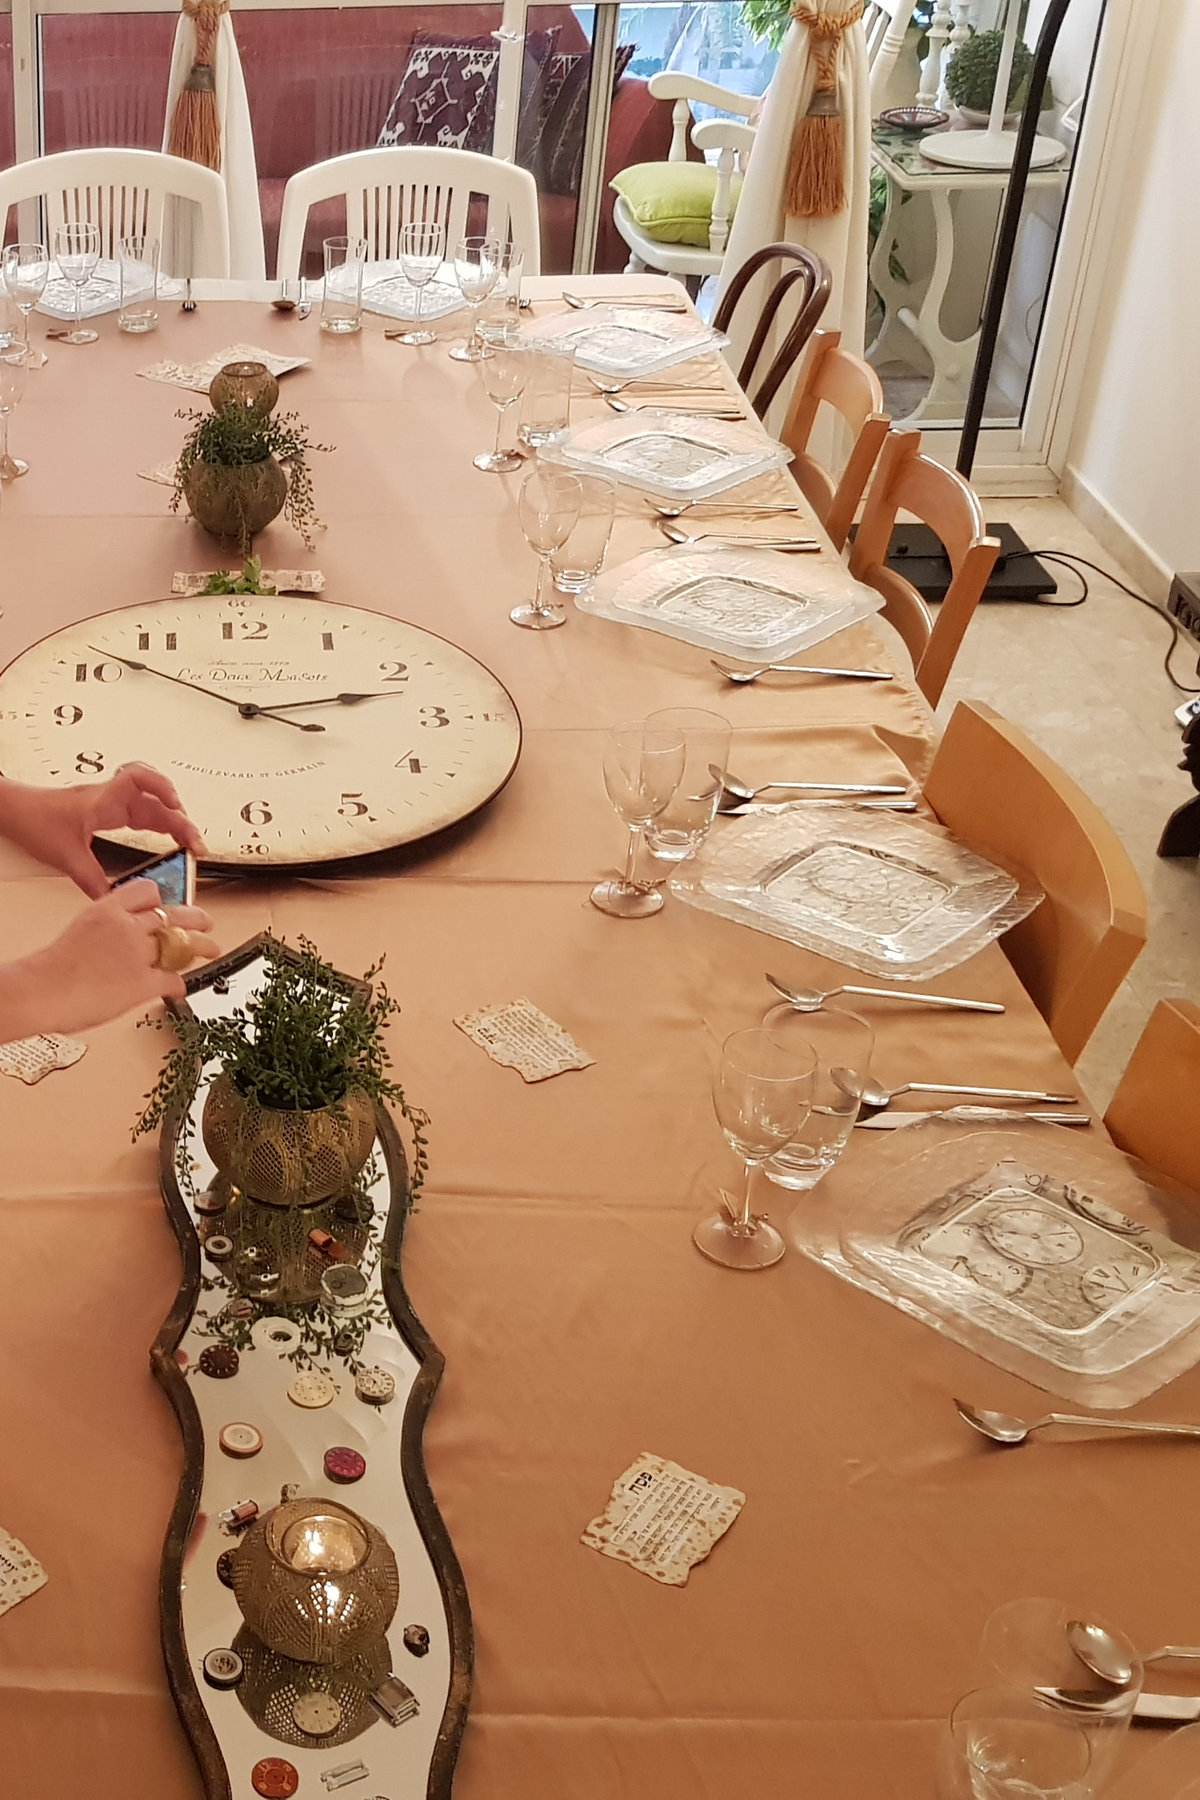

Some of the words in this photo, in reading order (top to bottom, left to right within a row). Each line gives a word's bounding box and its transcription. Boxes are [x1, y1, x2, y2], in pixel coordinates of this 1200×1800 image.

[228, 599, 253, 608] 60
[222, 621, 269, 640] 12
[138, 632, 177, 651] 11
[321, 632, 334, 651] 1
[75, 662, 123, 683] 10
[177, 668, 202, 681] Les
[209, 667, 250, 681] Deux
[379, 661, 410, 682] 2
[53, 704, 84, 727] 9
[419, 706, 450, 728] 3
[482, 712, 505, 722] 15
[75, 750, 105, 774] 8
[185, 764, 254, 778] BOULEVARD
[275, 760, 326, 777] GERMAIN
[394, 749, 428, 774] 4
[240, 800, 273, 825] 6
[337, 792, 370, 818] 5
[239, 844, 270, 856] 30
